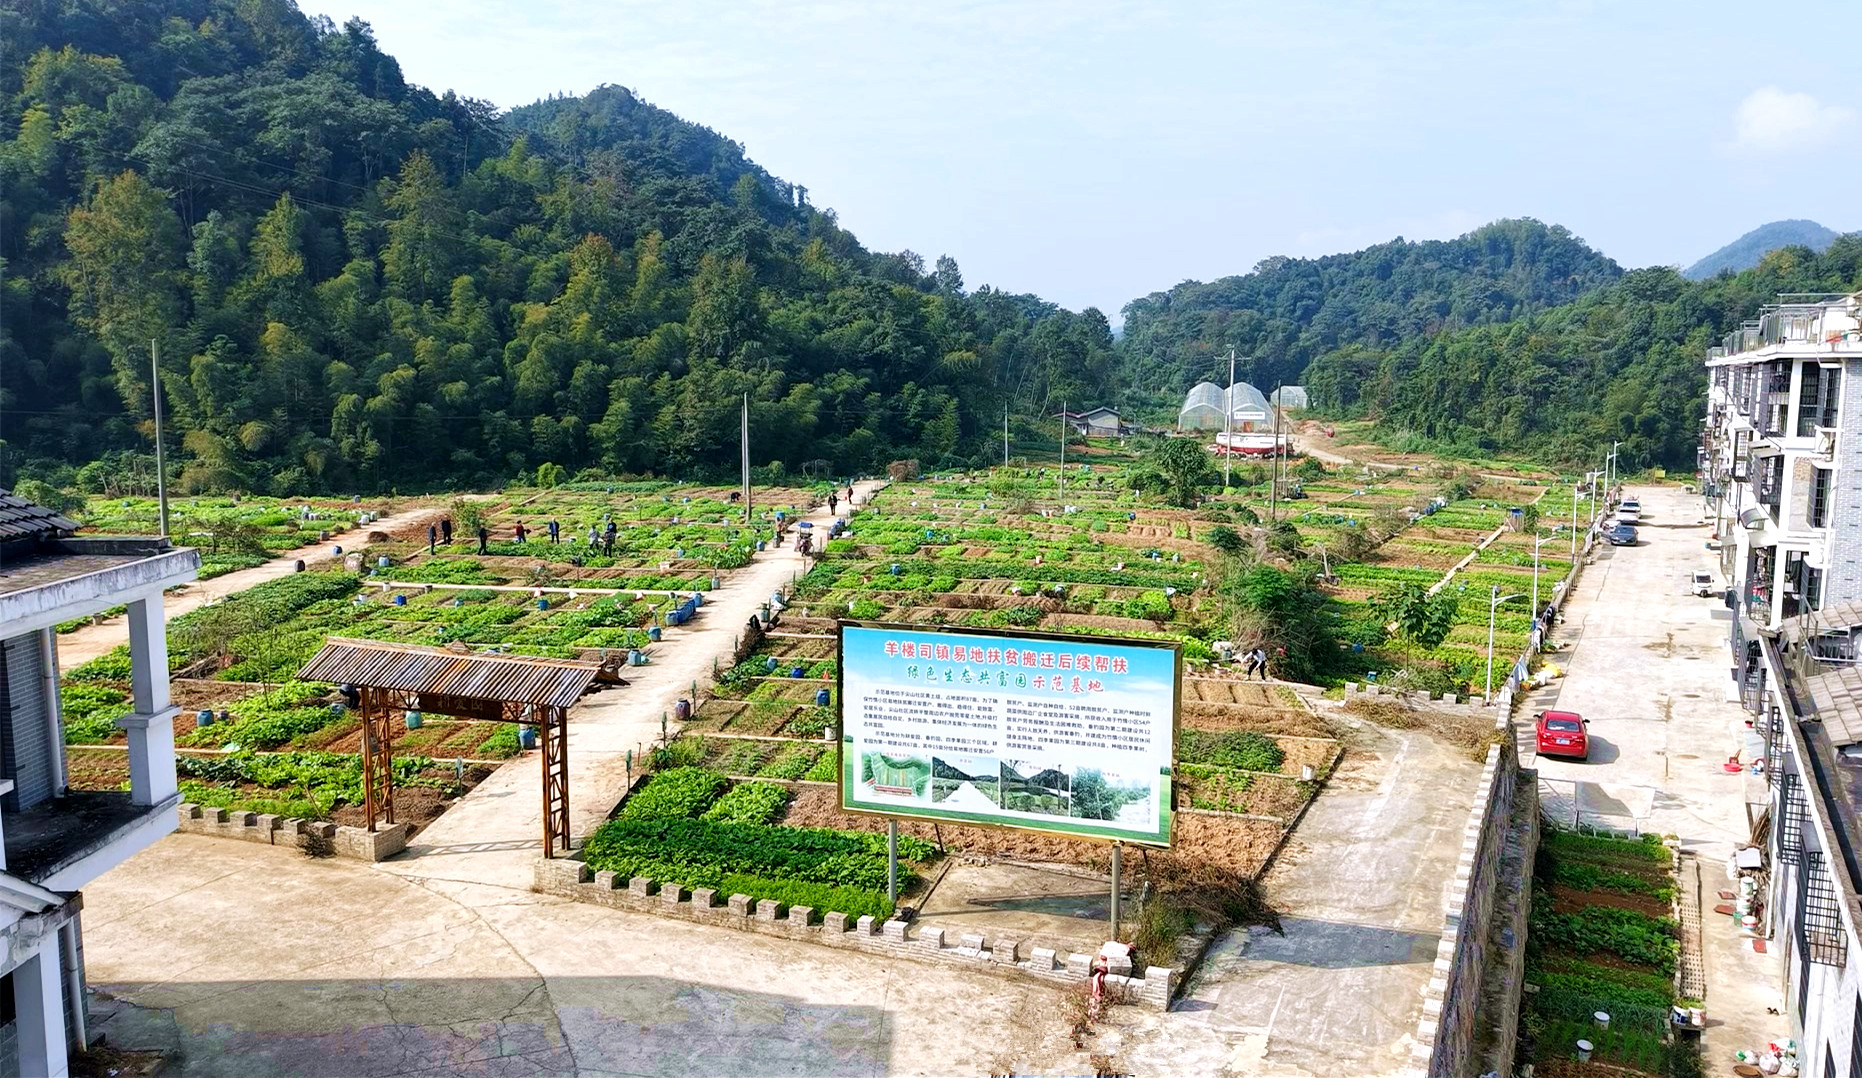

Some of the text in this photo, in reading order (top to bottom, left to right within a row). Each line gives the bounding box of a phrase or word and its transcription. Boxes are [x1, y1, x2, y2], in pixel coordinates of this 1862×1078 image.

[885, 641, 1127, 672] 羊楼司镇易地扶贫搬迁后续帮扶
[907, 665, 1104, 692] 绿色生态共富园示范基地
